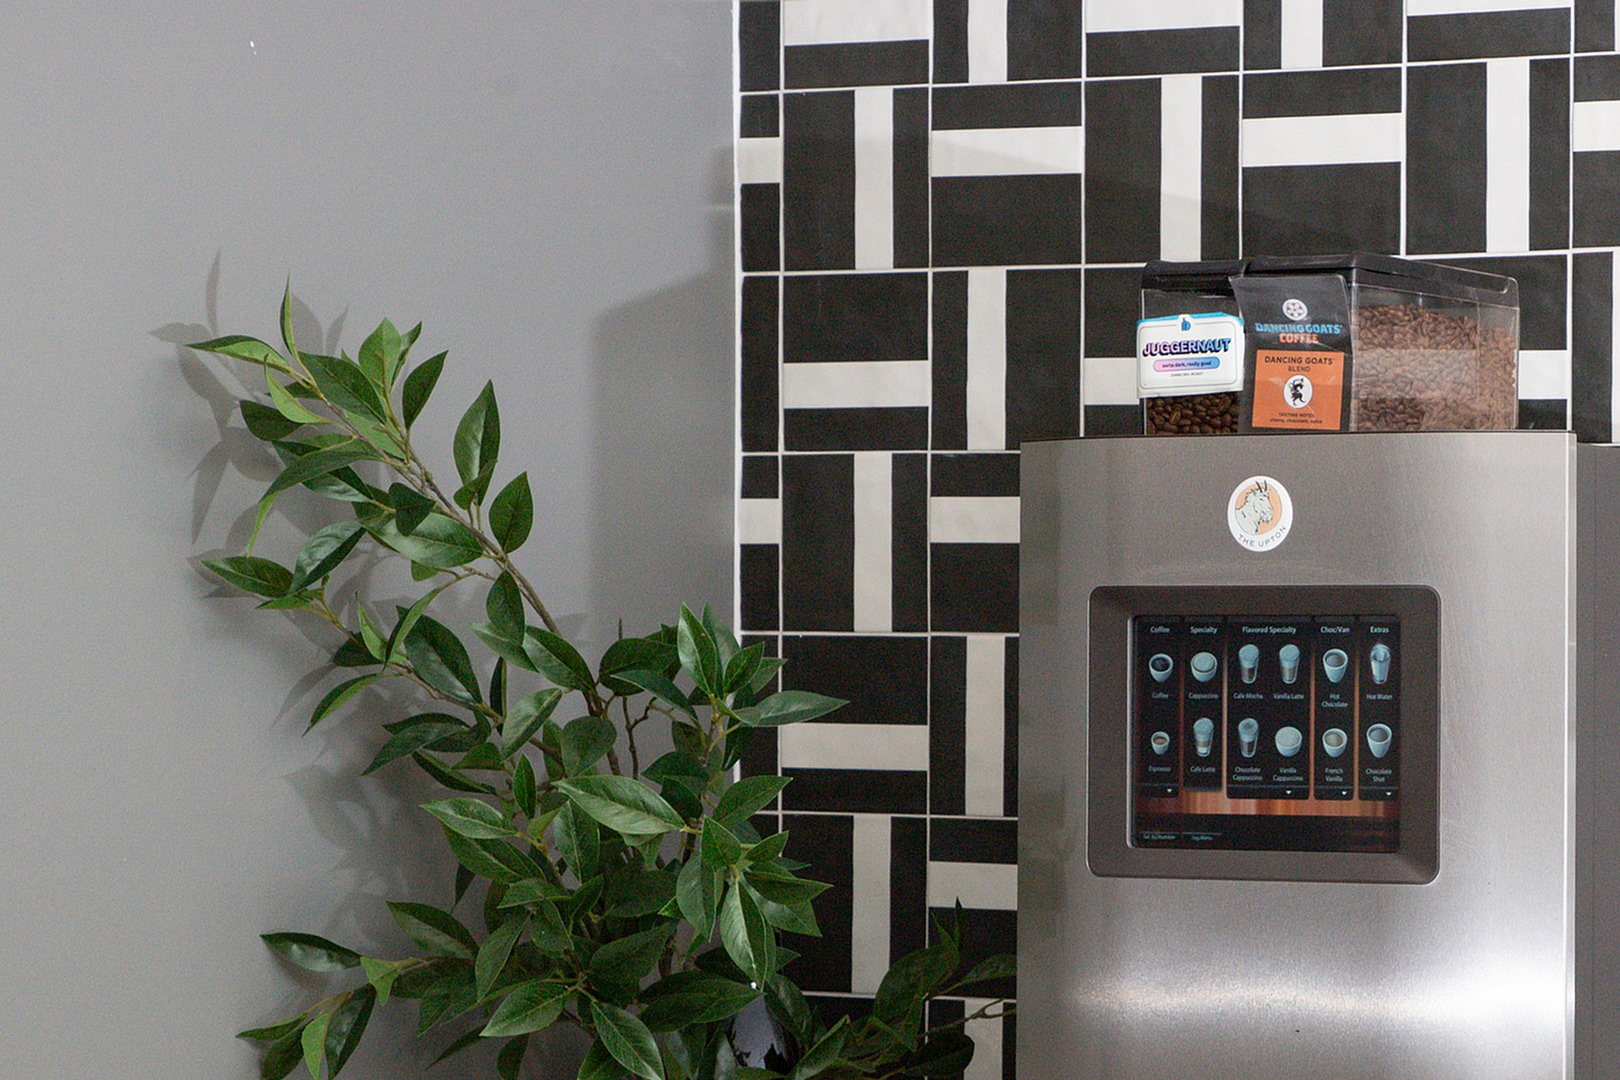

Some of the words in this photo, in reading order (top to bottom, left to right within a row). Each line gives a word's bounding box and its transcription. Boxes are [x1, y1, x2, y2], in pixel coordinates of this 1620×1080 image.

[1254, 322, 1304, 333] DANCING
[1279, 333, 1319, 344] COFFEE
[1142, 337, 1232, 357] JUGGERNAUT
[1264, 355, 1303, 364] DANCING
[1304, 356, 1333, 366] GOATS
[1287, 365, 1311, 373] BLEND
[1238, 533, 1255, 547] THE
[1258, 525, 1287, 548] UPTON
[1190, 626, 1218, 635] Specialty
[1269, 626, 1297, 635] Specialty
[1320, 626, 1350, 634] Choc/Van
